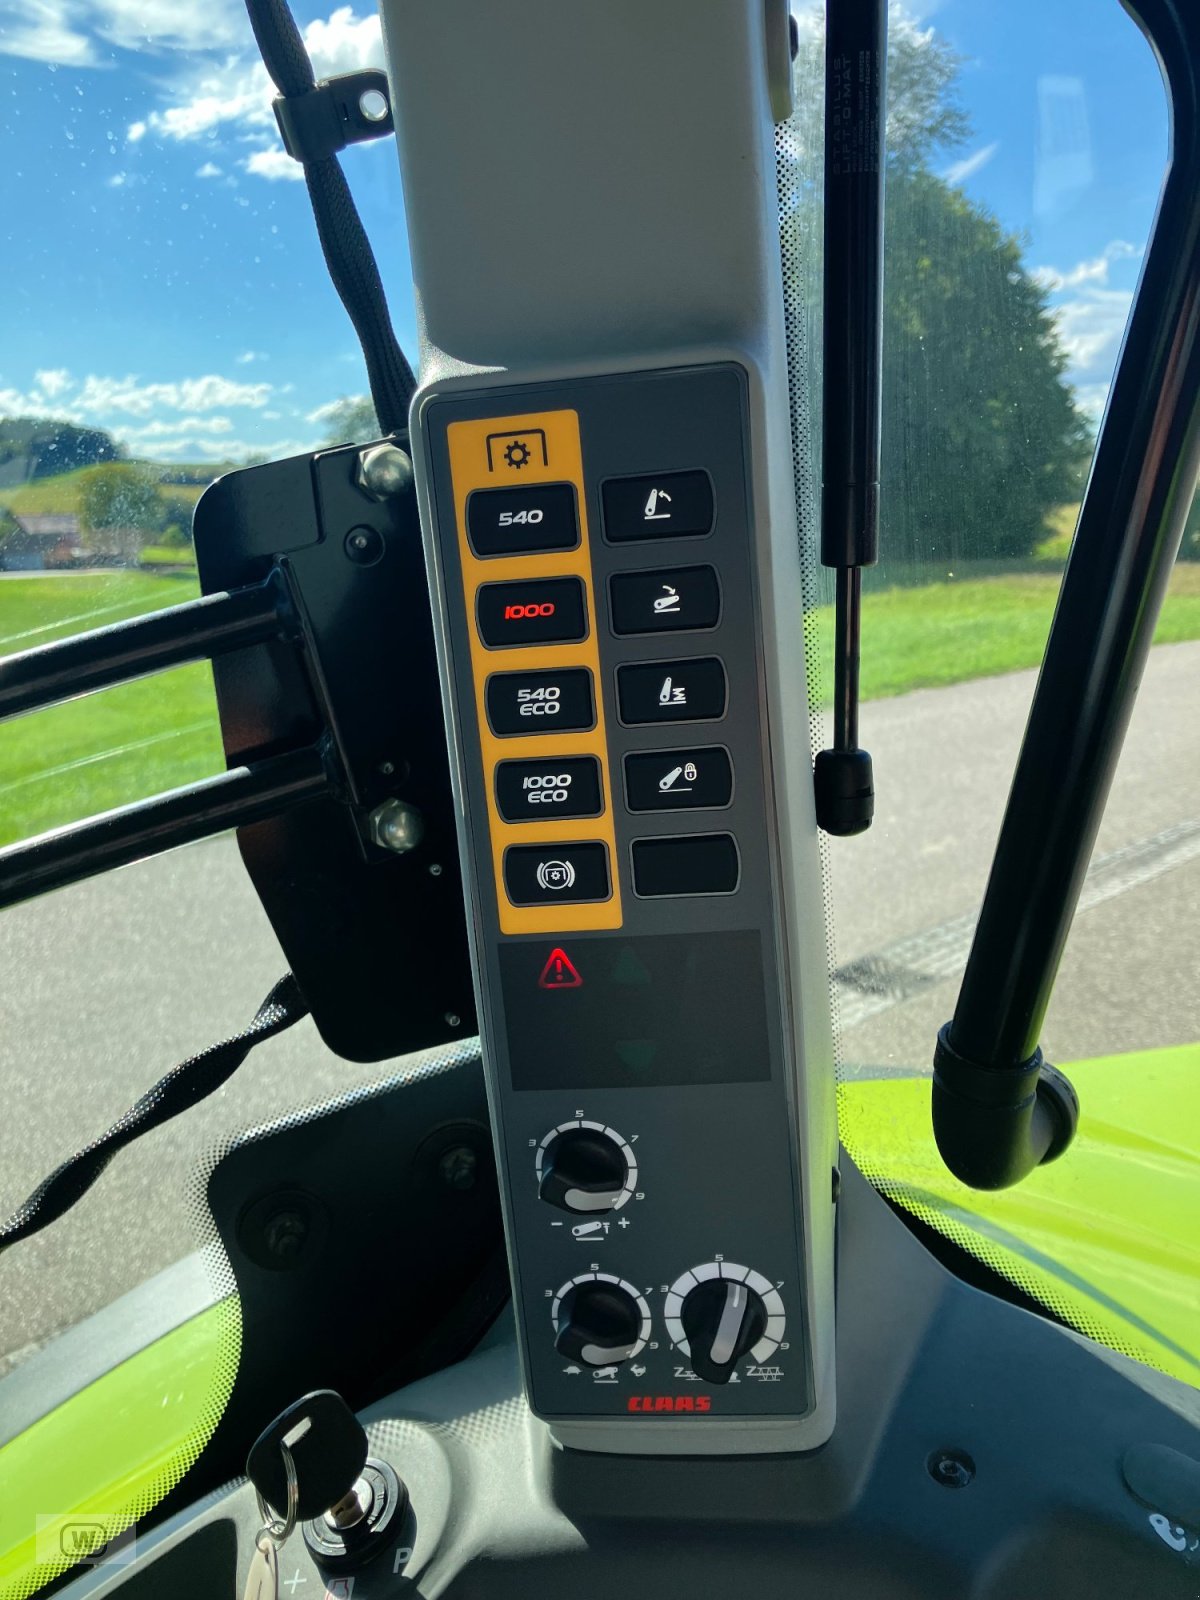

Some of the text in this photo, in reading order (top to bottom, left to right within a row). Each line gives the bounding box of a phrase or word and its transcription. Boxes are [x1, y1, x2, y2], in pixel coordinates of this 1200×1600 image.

[498, 509, 544, 527] 540
[504, 603, 555, 620] 1000
[517, 686, 561, 703] 540
[519, 701, 561, 716] ECO
[522, 773, 572, 789] 1000
[527, 788, 568, 804] ECO
[574, 1109, 584, 1118] 5
[528, 1138, 537, 1147] 3
[630, 1134, 639, 1143] 7
[635, 1192, 645, 1201] 9
[714, 1253, 724, 1262] 5
[590, 1263, 600, 1271] 5
[660, 1284, 669, 1293] 3
[776, 1281, 785, 1289] 7
[544, 1289, 553, 1297] 3
[645, 1287, 654, 1295] 7
[649, 1341, 659, 1350] 9
[780, 1342, 790, 1350] 9
[628, 1396, 711, 1412] CLAAS
